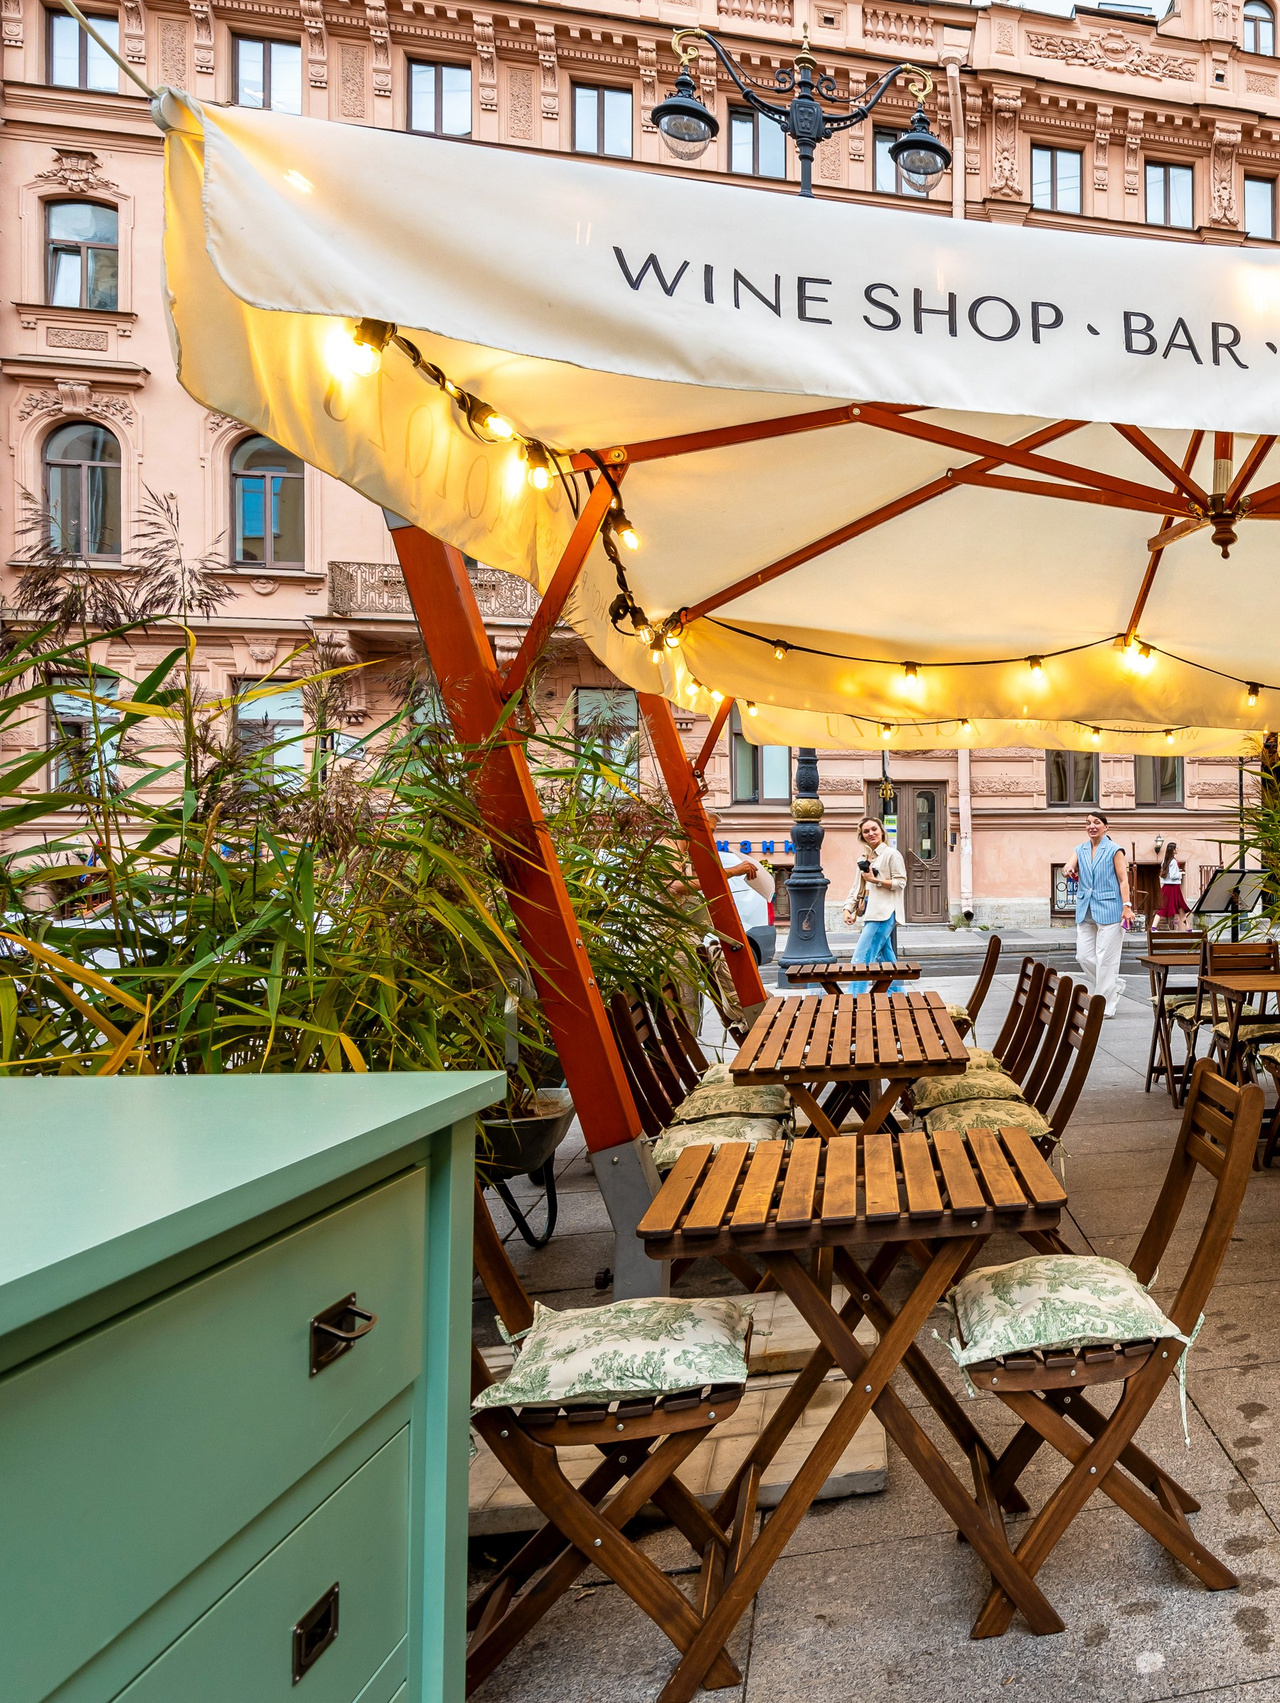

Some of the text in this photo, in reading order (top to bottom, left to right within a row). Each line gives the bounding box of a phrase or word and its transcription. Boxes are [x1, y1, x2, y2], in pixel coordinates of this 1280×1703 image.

[612, 245, 833, 325] WINE
[863, 281, 1064, 343] SHOP
[1123, 310, 1249, 369] BAR
